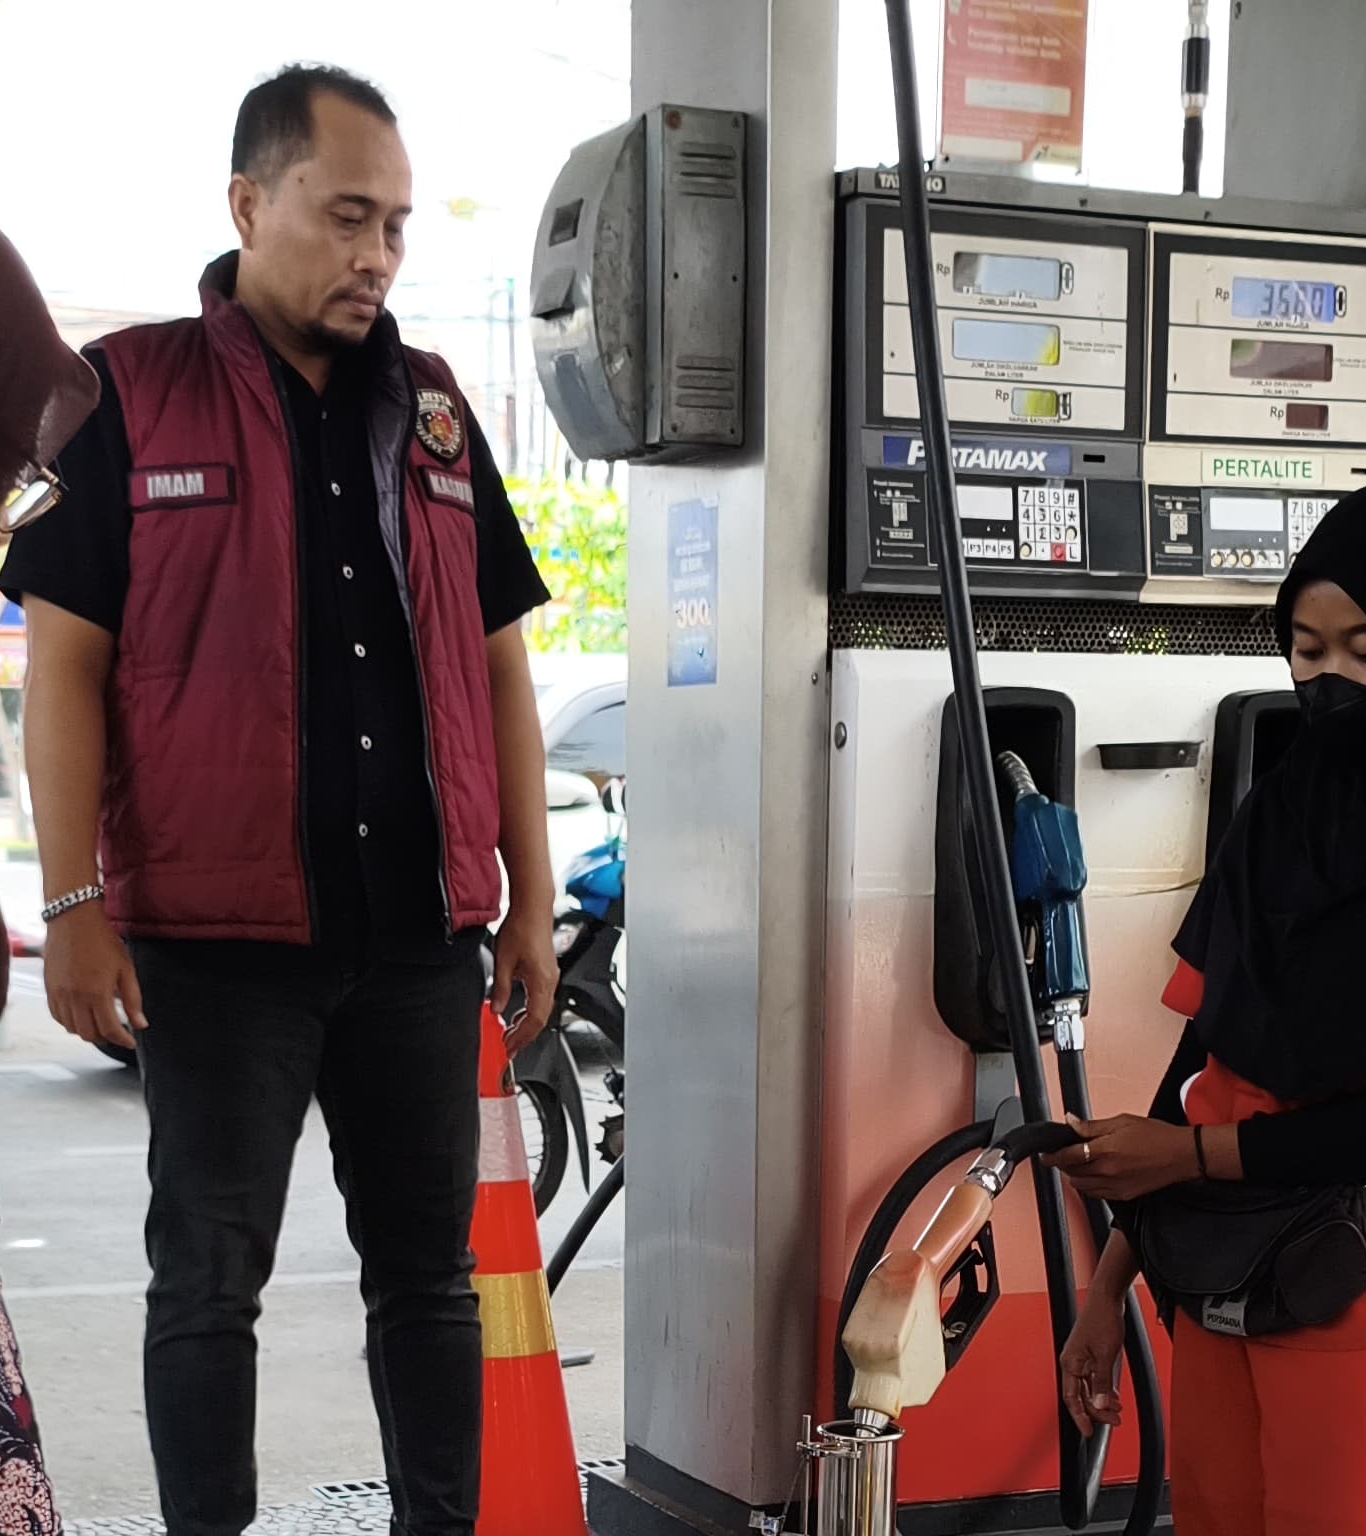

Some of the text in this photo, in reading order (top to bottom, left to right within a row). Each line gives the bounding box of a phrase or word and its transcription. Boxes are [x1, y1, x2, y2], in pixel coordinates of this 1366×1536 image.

[1215, 287, 1230, 301] Rp
[995, 389, 1009, 403] Rp
[1270, 406, 1284, 421] Rp
[907, 440, 1048, 472] PTAMAX
[1213, 459, 1313, 479] PERTALITE
[147, 472, 205, 499] IMAM
